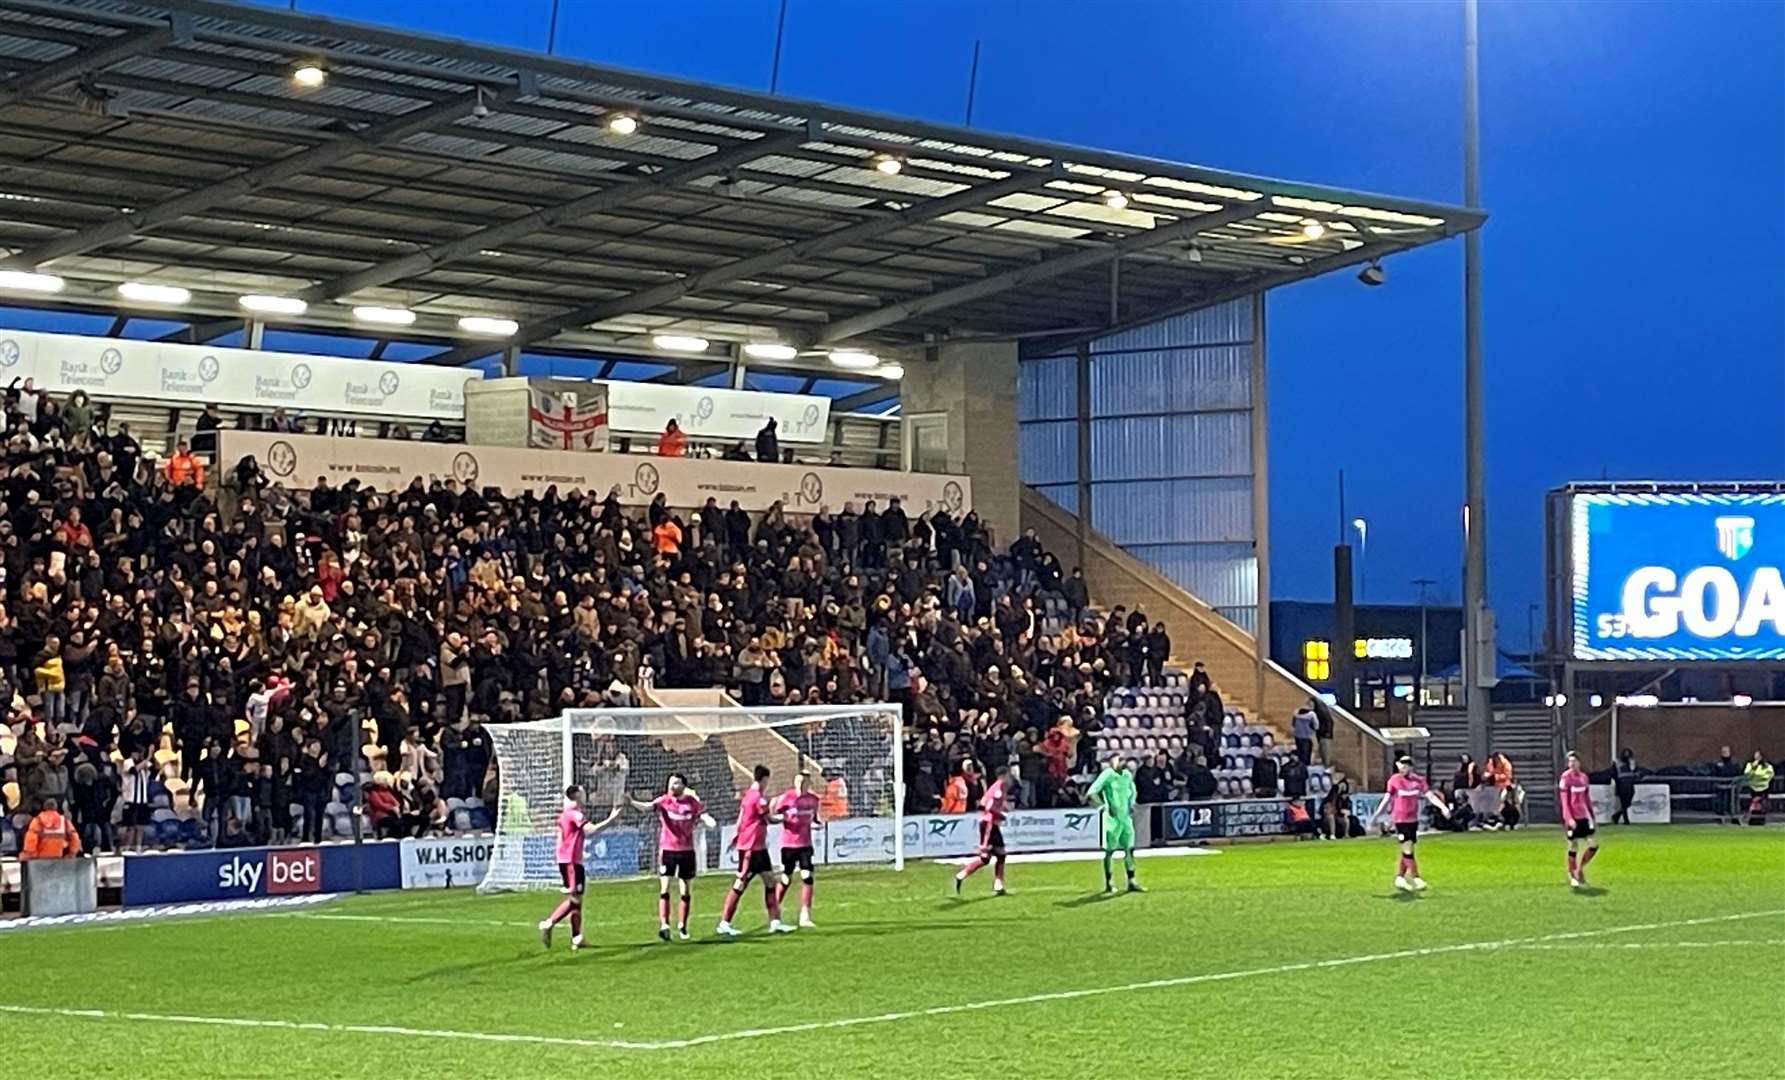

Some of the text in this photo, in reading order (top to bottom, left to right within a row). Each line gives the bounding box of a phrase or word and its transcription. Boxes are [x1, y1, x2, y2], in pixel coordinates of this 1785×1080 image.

[1622, 566, 1785, 639] GOA
[218, 855, 316, 893] sky bet
